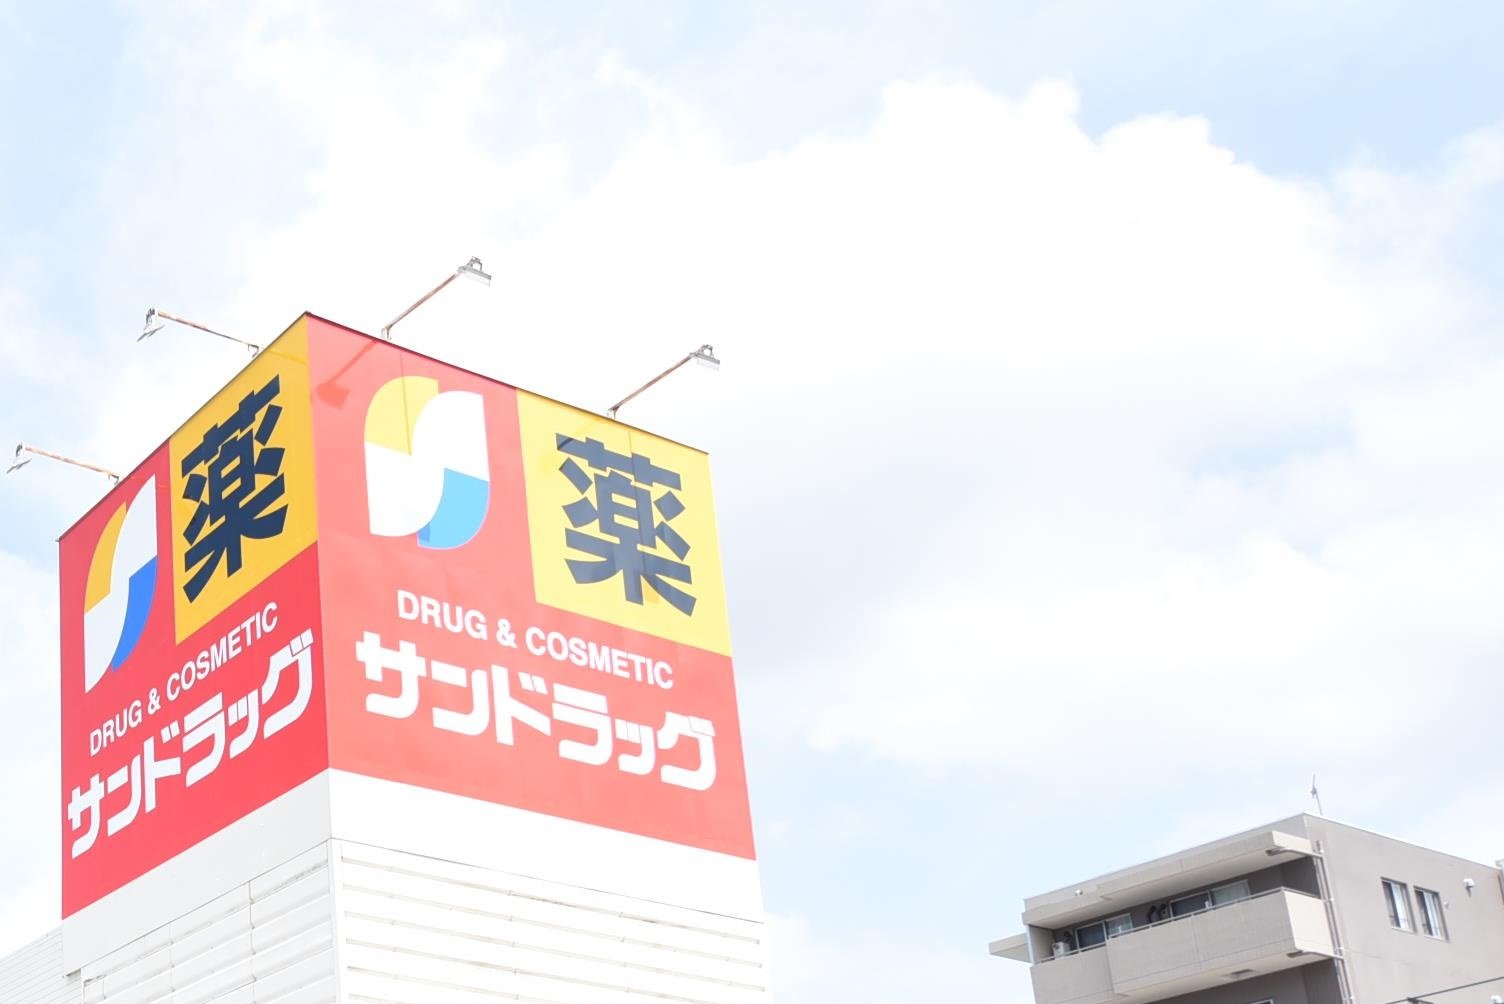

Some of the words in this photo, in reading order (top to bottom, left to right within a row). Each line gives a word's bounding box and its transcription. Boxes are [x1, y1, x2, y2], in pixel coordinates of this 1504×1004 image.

[181, 374, 290, 604] 薬
[555, 432, 697, 618] 薬
[88, 706, 143, 757] DRUG
[147, 690, 162, 713] &
[166, 601, 278, 701] COSMETIC
[355, 630, 717, 791] サンドラッグ
[397, 589, 487, 641] DRUG
[497, 618, 517, 645] &
[525, 627, 673, 690] COSMETIC
[67, 628, 315, 860] サンドラッグ
